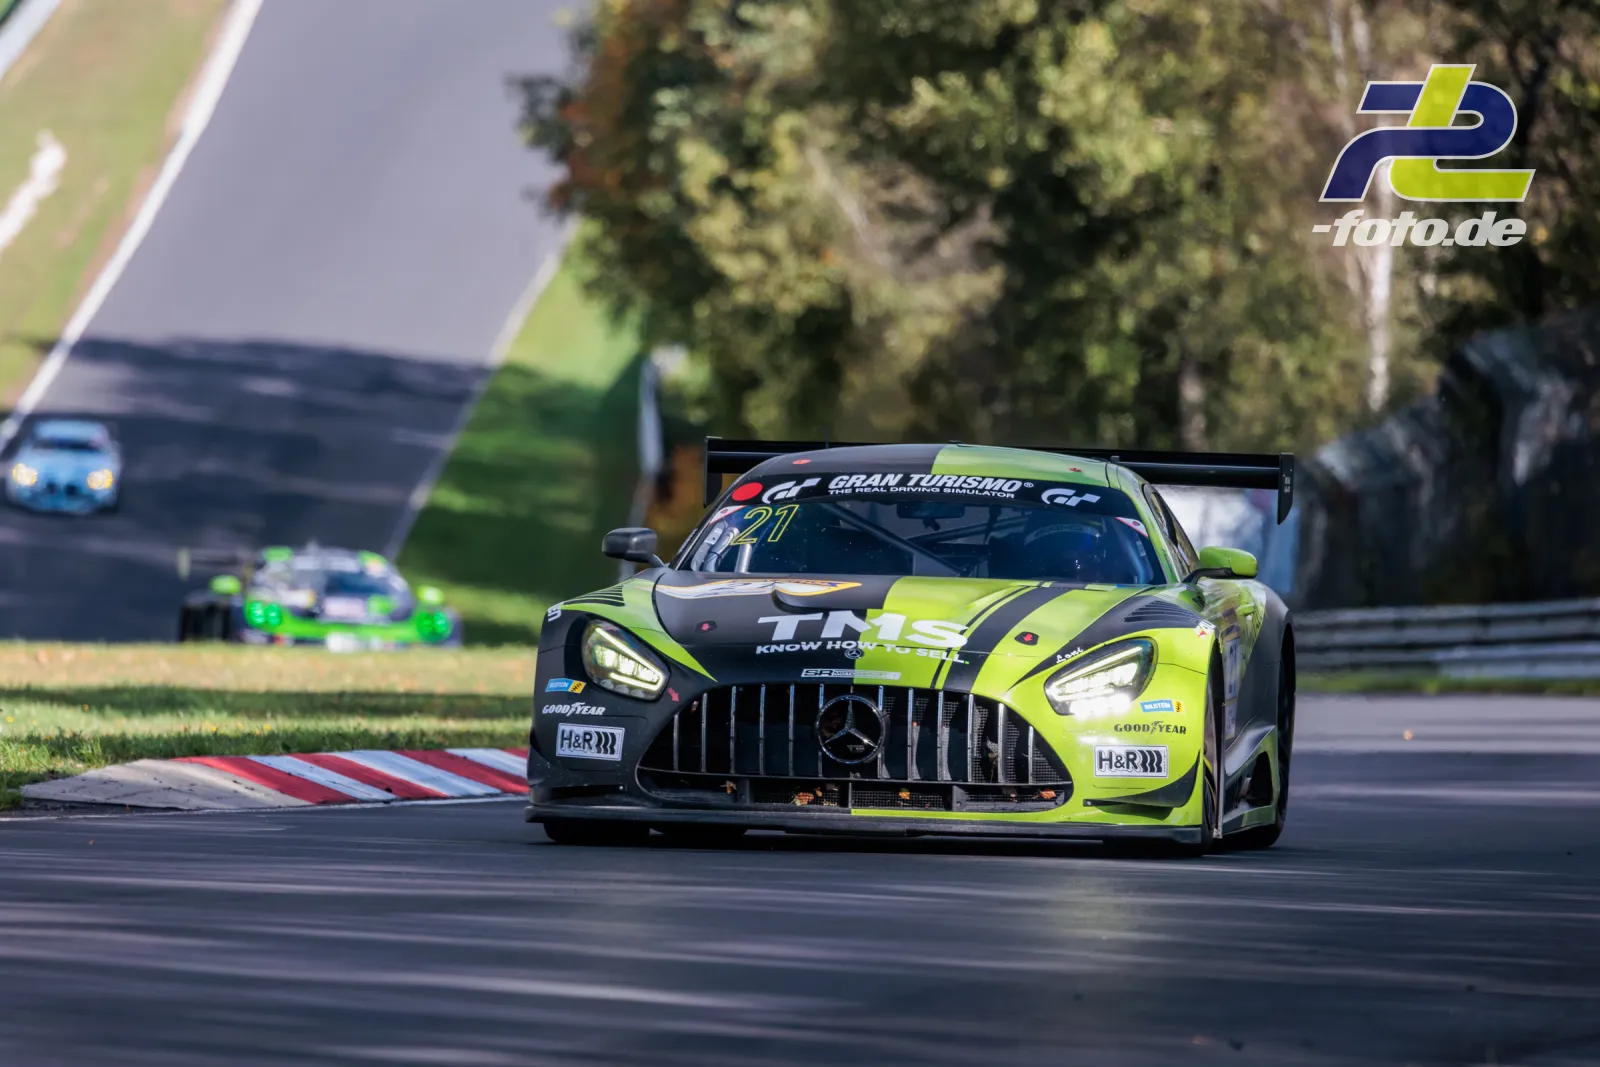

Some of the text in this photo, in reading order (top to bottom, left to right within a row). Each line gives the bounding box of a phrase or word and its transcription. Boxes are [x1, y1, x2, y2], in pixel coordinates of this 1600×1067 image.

[828, 473, 904, 490] GRAN
[828, 486, 1016, 499] THE REAL DRIVING SIMULATOR
[729, 503, 800, 547] 21
[757, 609, 969, 648] TMS
[755, 641, 823, 655] KNOW
[826, 639, 879, 651] HOW
[883, 643, 912, 655] TO
[559, 728, 594, 751] H&R
[1097, 750, 1139, 772] H&R
